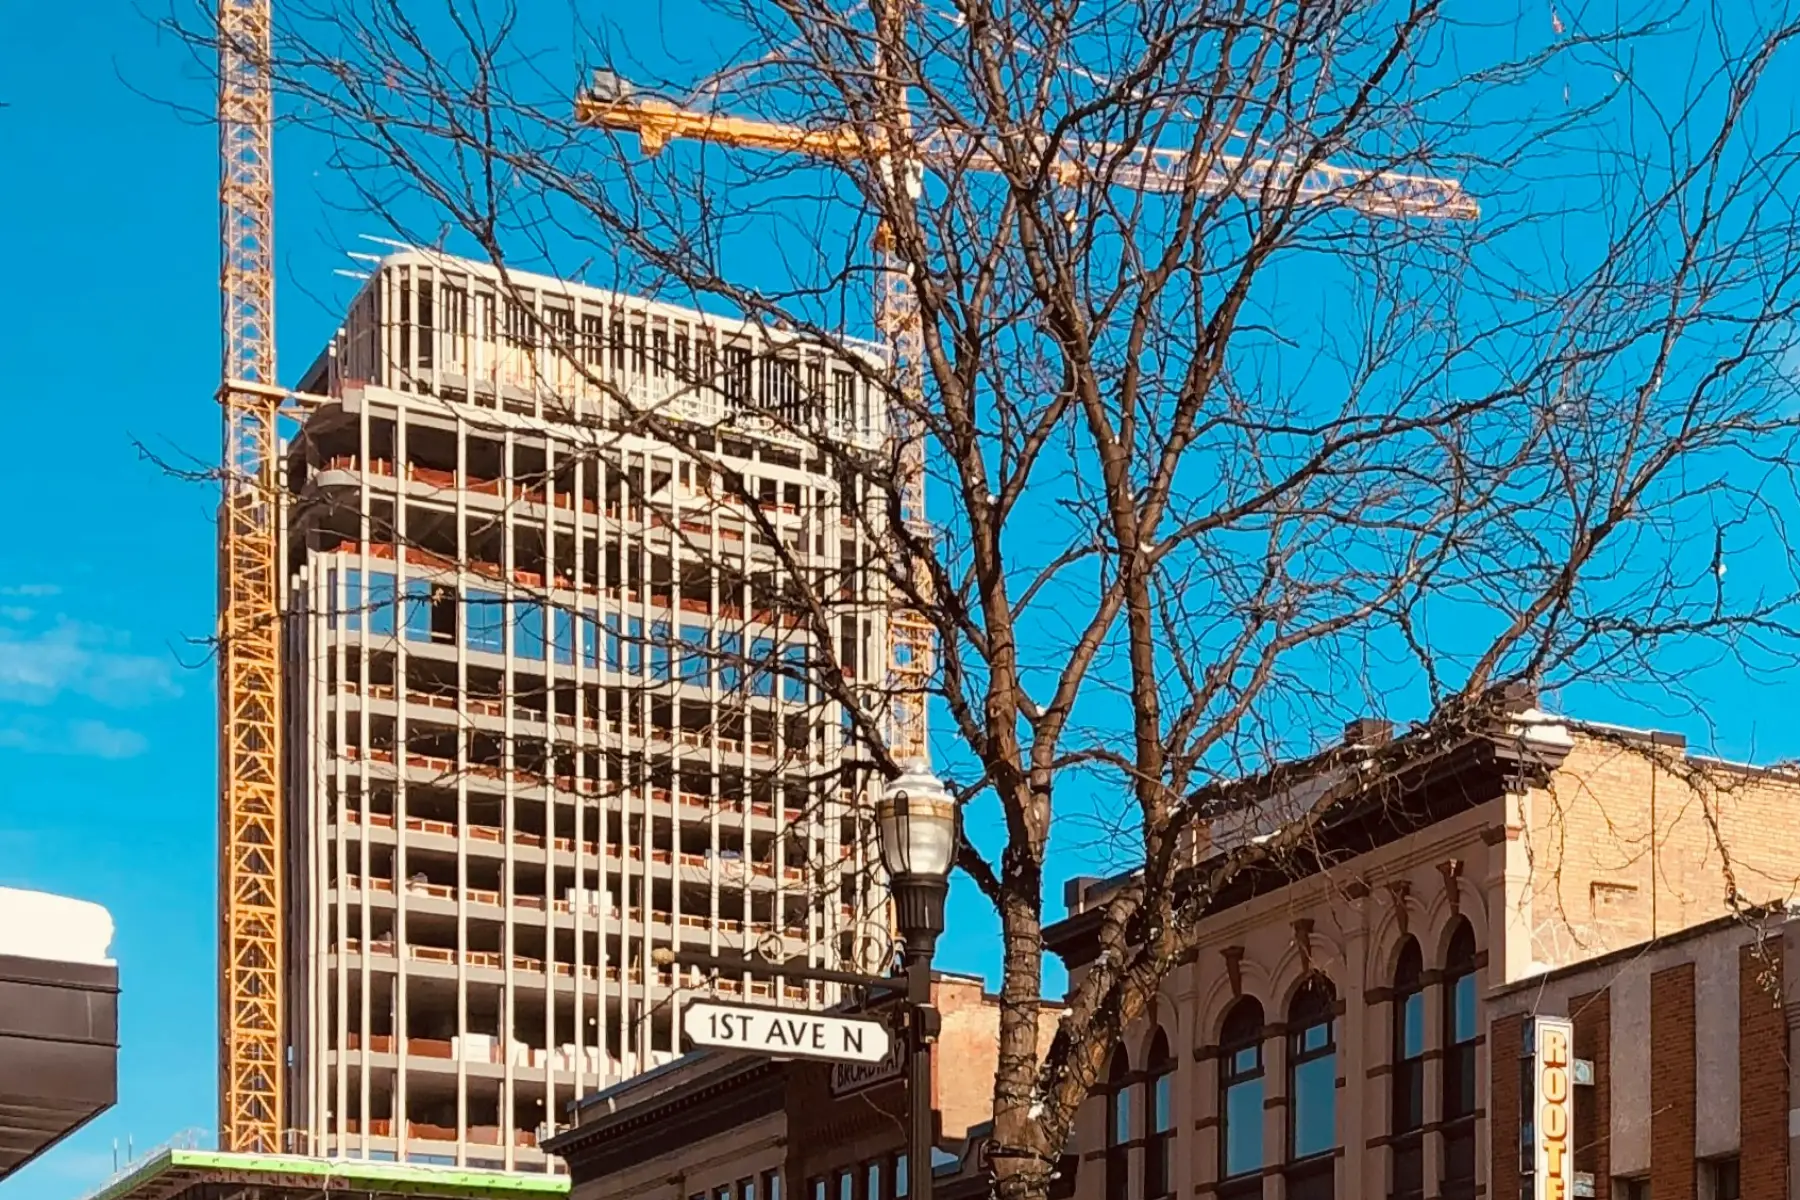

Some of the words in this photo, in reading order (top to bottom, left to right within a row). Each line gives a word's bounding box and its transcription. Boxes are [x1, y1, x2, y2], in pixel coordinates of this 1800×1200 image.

[709, 1012, 753, 1042] 1ST
[765, 1019, 826, 1049] AVE
[842, 1025, 863, 1053] N
